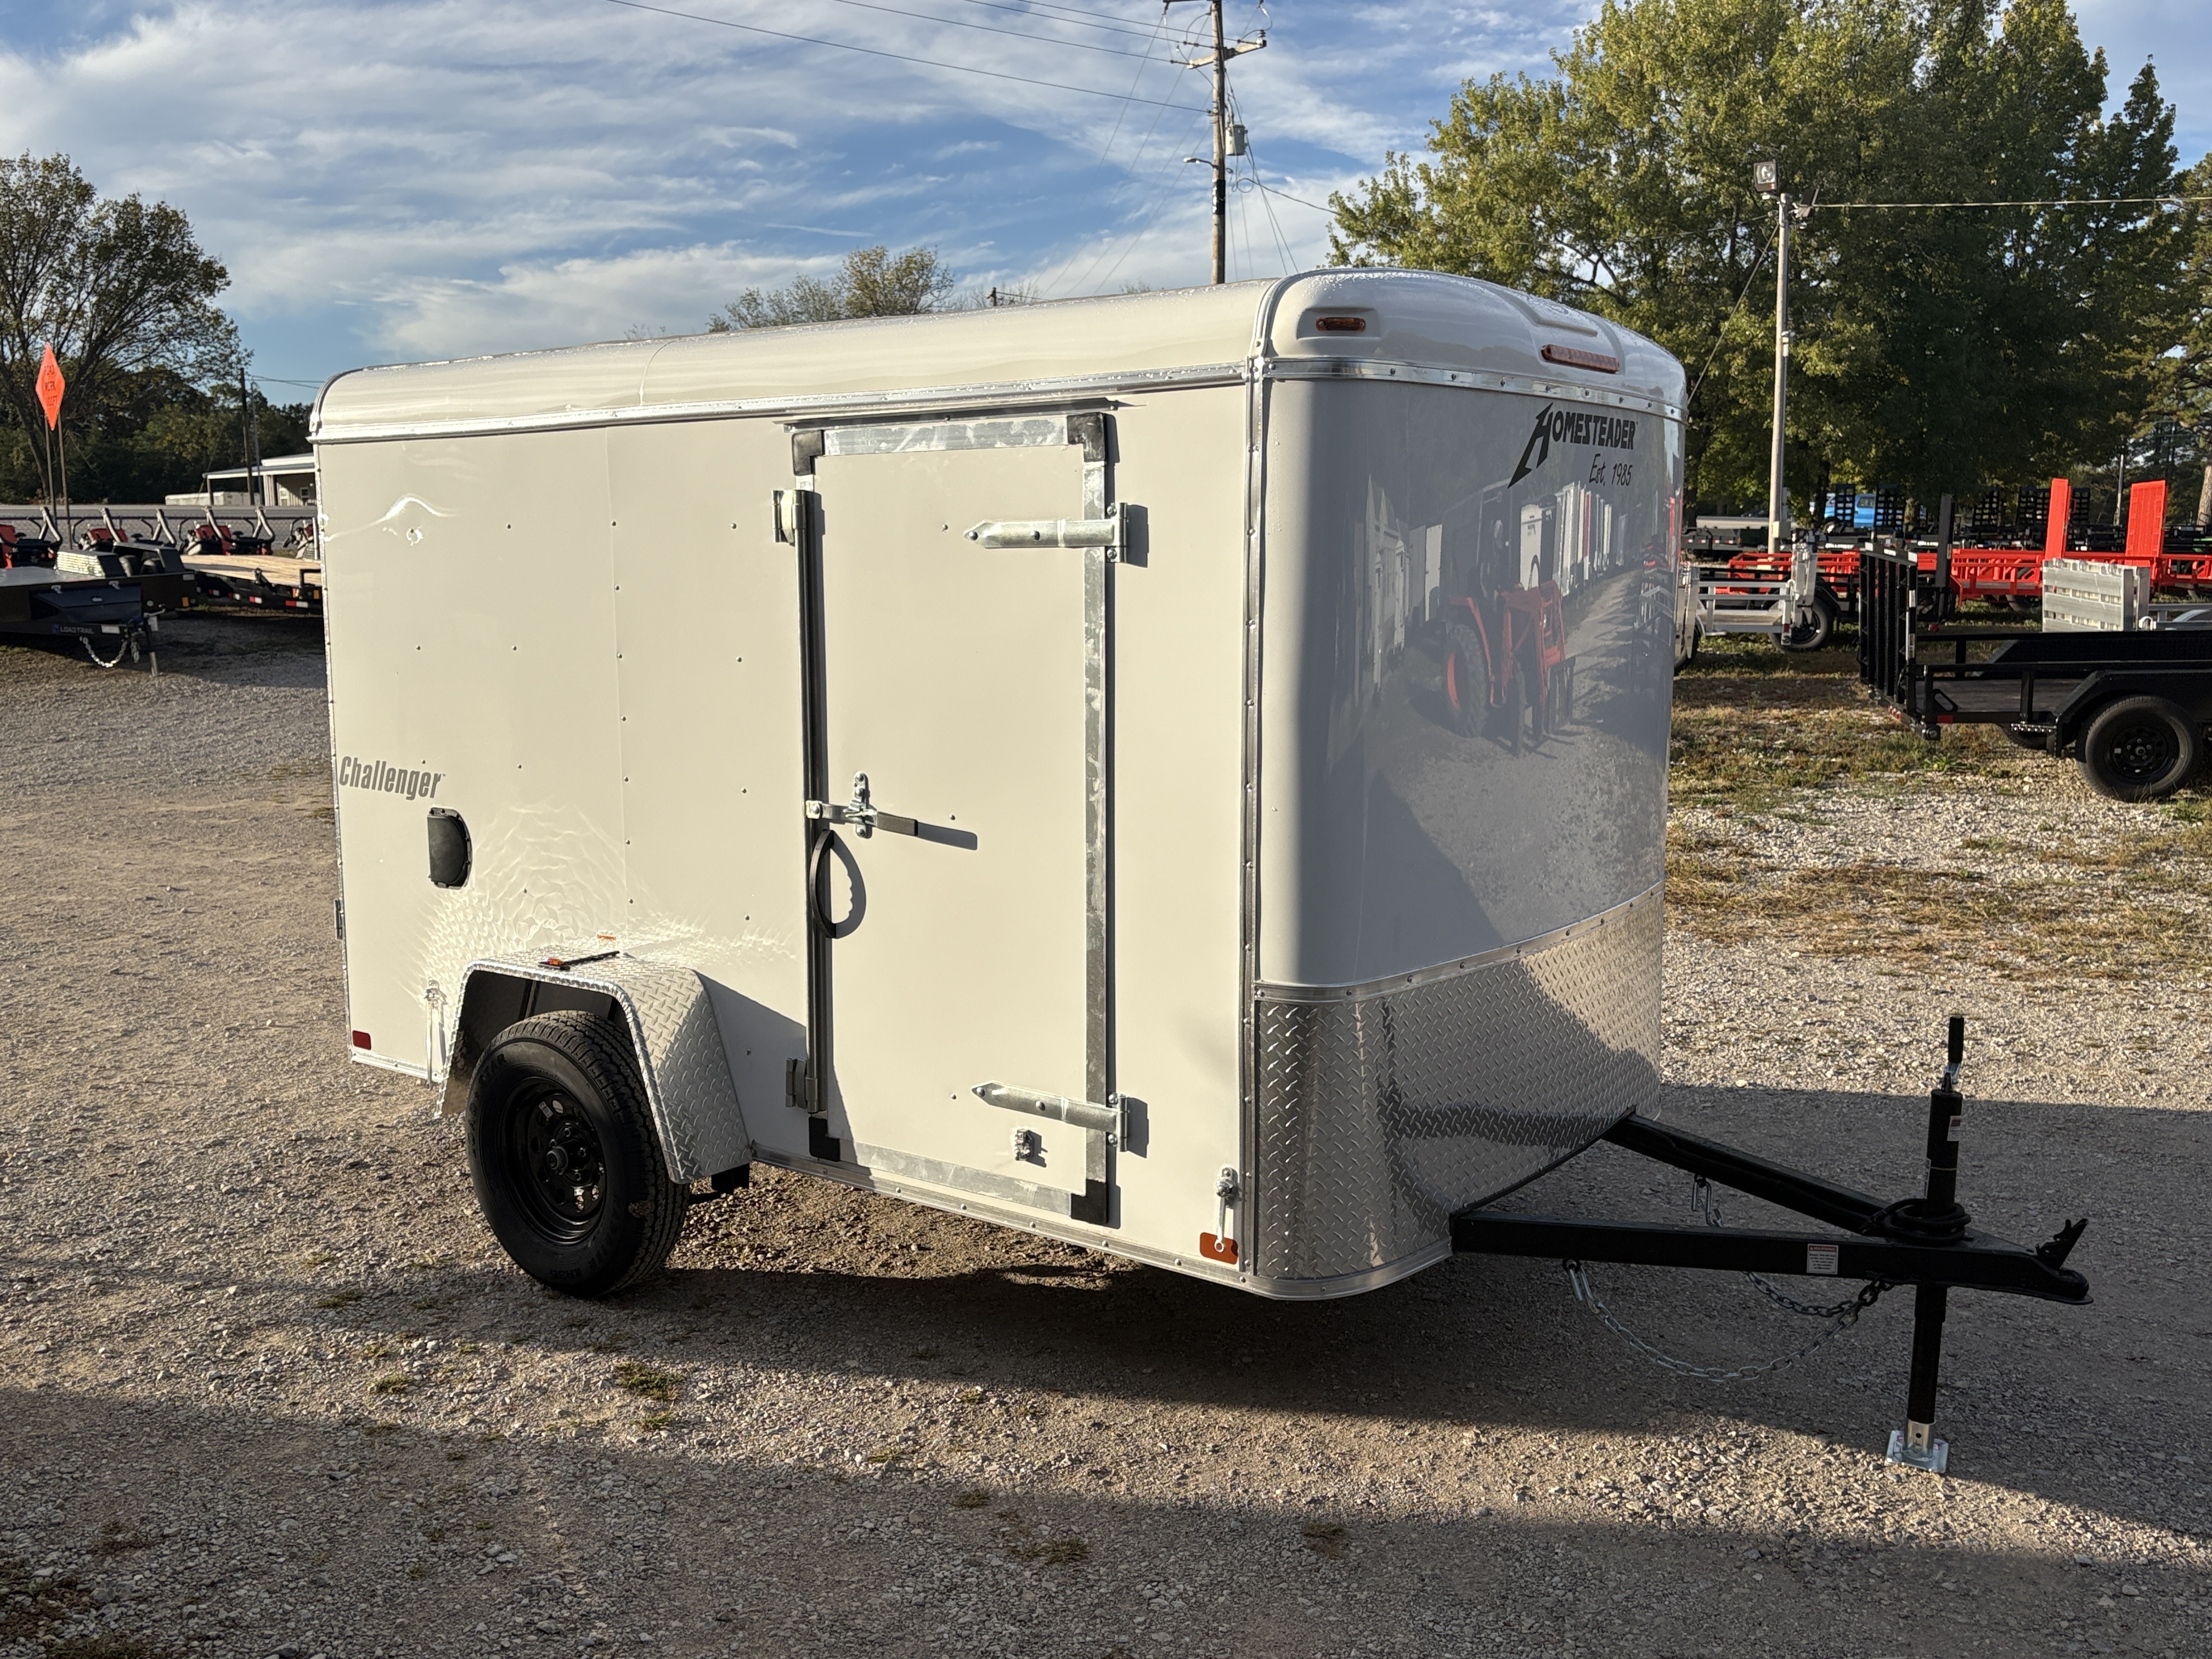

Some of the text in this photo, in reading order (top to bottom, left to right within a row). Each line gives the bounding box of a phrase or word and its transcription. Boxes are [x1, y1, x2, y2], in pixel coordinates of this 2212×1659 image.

[1508, 402, 1636, 489] HOMESTEADER
[1589, 453, 1634, 487] Est. 1985
[339, 756, 442, 800] Challenger
